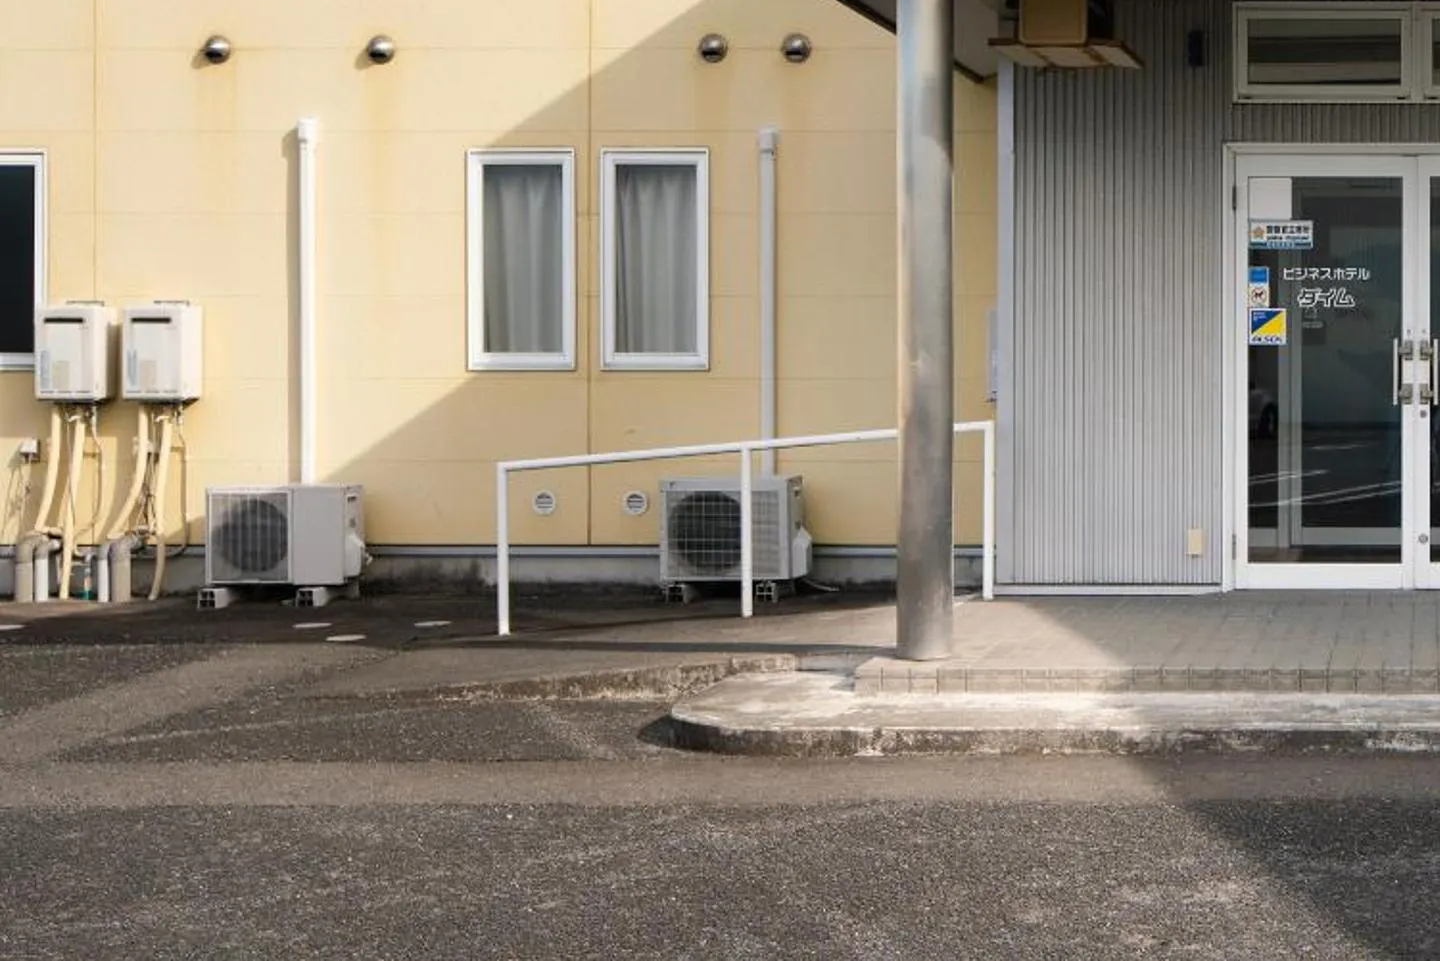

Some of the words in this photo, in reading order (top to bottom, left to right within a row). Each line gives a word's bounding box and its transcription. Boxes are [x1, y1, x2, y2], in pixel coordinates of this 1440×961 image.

[1283, 267, 1370, 280] ビジネスホテル
